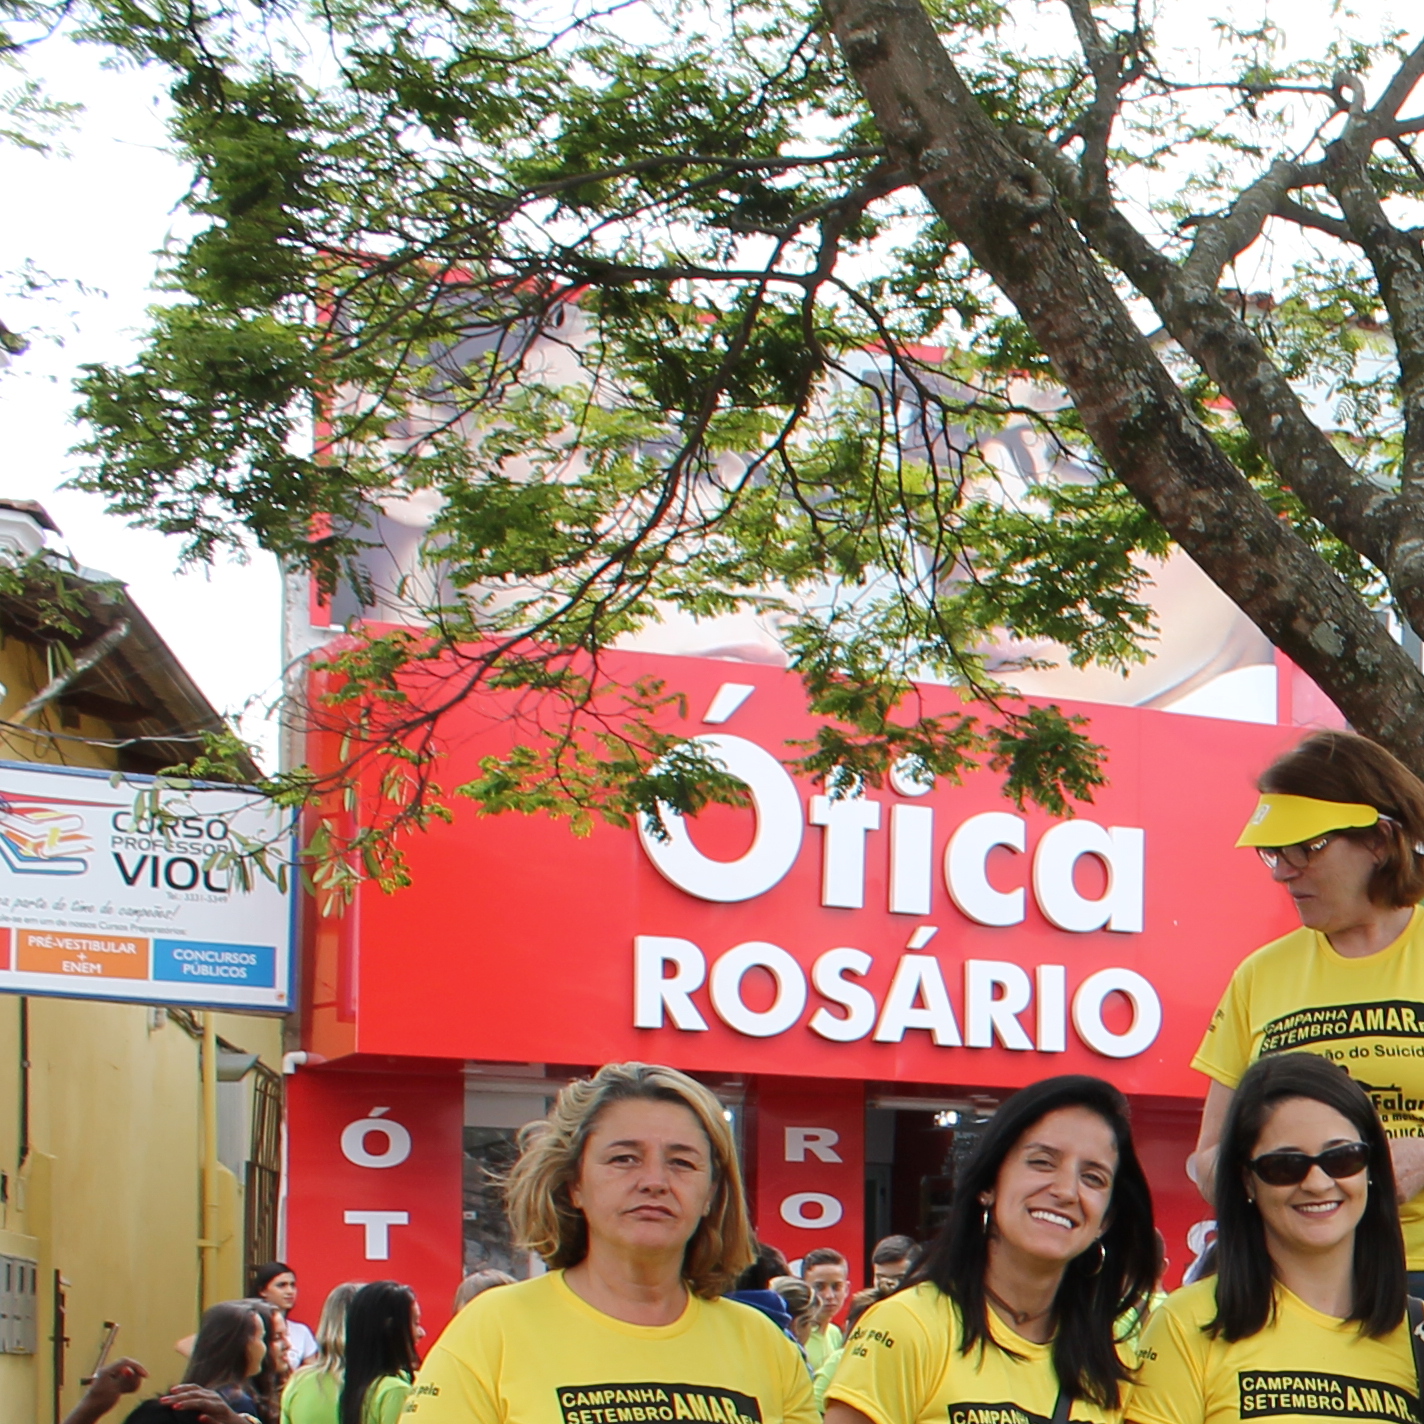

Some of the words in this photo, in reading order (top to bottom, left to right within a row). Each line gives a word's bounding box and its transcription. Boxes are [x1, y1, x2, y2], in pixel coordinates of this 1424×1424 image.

[637, 683, 1145, 933] Ótica
[112, 811, 229, 840] CURSO
[111, 835, 228, 857] PROFESSOR
[27, 934, 137, 955] PRÉ-VESTIBULAR
[172, 948, 257, 965] CONCURSOS
[62, 961, 102, 975] ENEM
[182, 962, 248, 979] PÚBLICOS
[632, 926, 1163, 1058] ROSÁRIO
[1265, 1008, 1348, 1035] CAMPANHA
[1261, 1022, 1347, 1052] SETEMBRO
[1349, 1046, 1370, 1060] do
[1241, 1376, 1342, 1394] CAMPANHA
[561, 1388, 669, 1408] CAMPANHA
[1243, 1395, 1344, 1412] SETEMBRO
